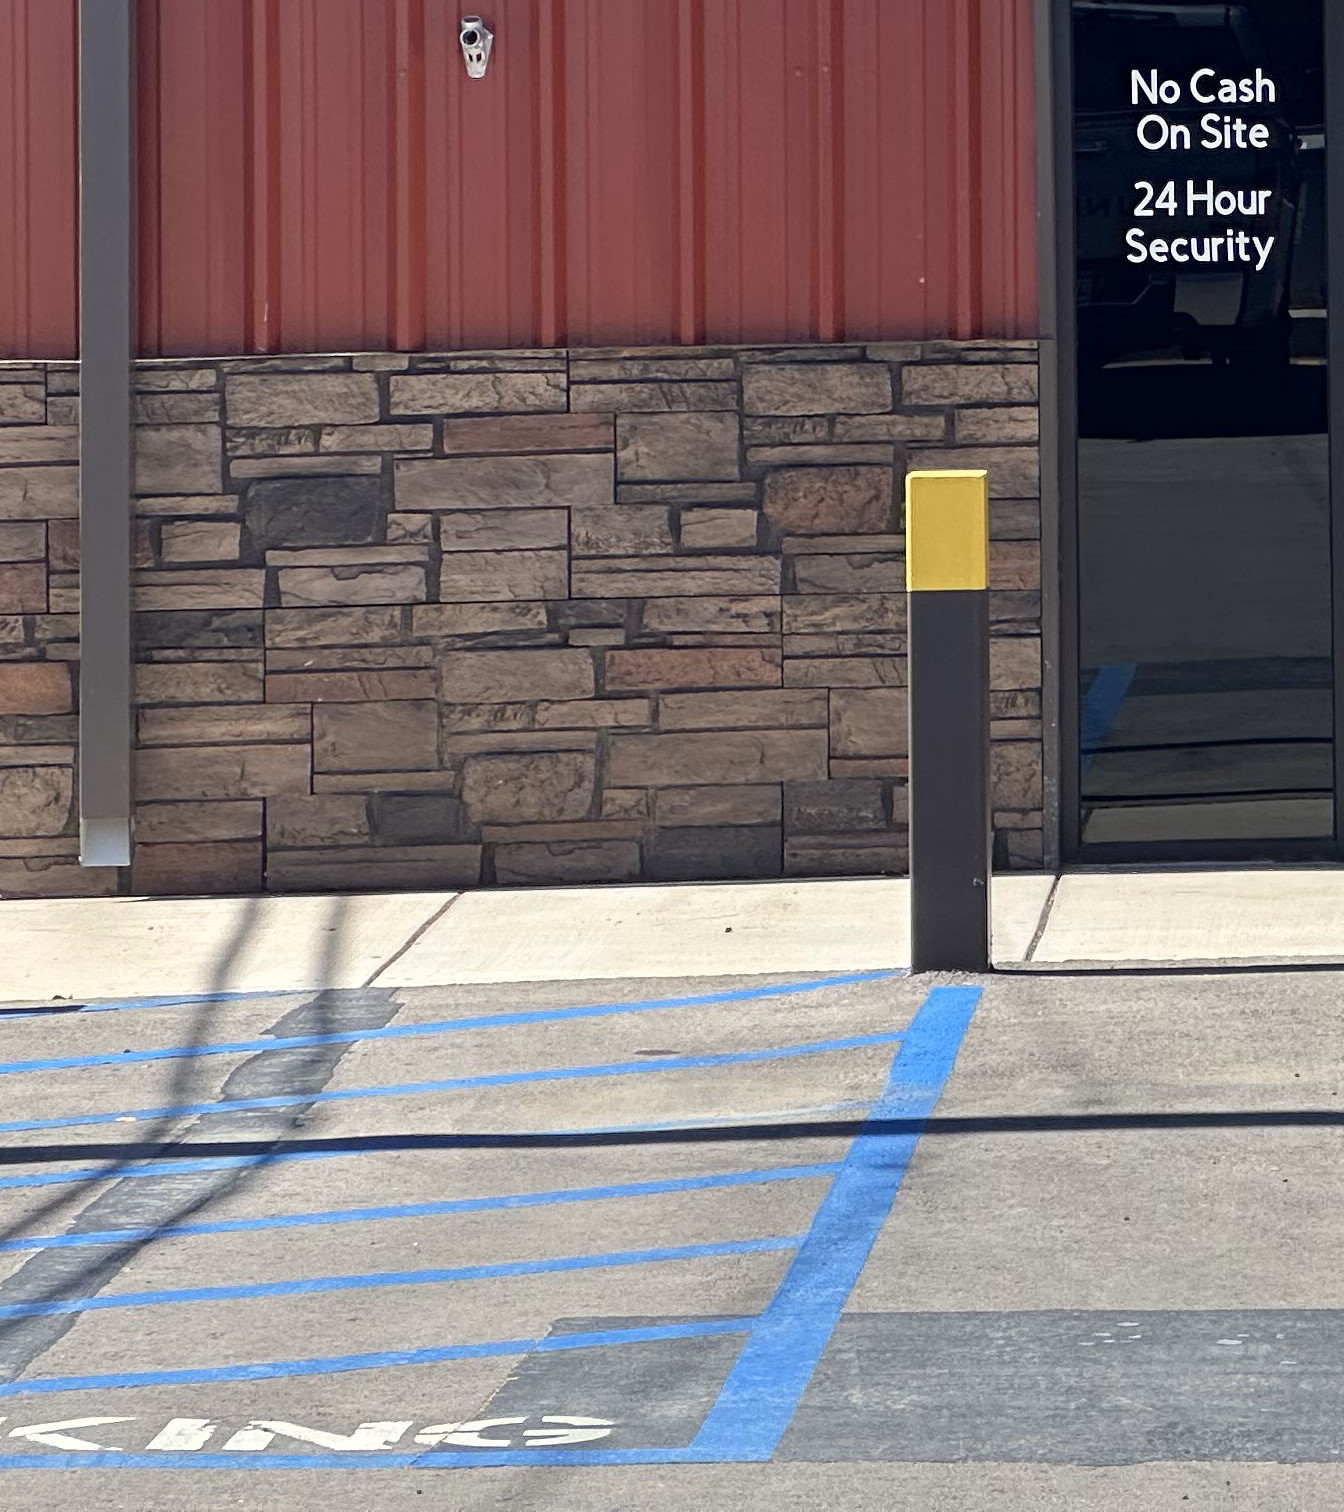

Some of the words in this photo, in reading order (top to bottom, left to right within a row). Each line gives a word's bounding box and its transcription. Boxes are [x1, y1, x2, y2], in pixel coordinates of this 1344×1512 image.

[1131, 68, 1181, 105] No
[1190, 67, 1276, 104] Cash
[1136, 113, 1191, 151] On
[1200, 112, 1270, 150] Site
[1133, 180, 1178, 217] 24
[1186, 179, 1273, 217] Hour
[1125, 227, 1275, 272] Security
[0, 1415, 618, 1451] KING
